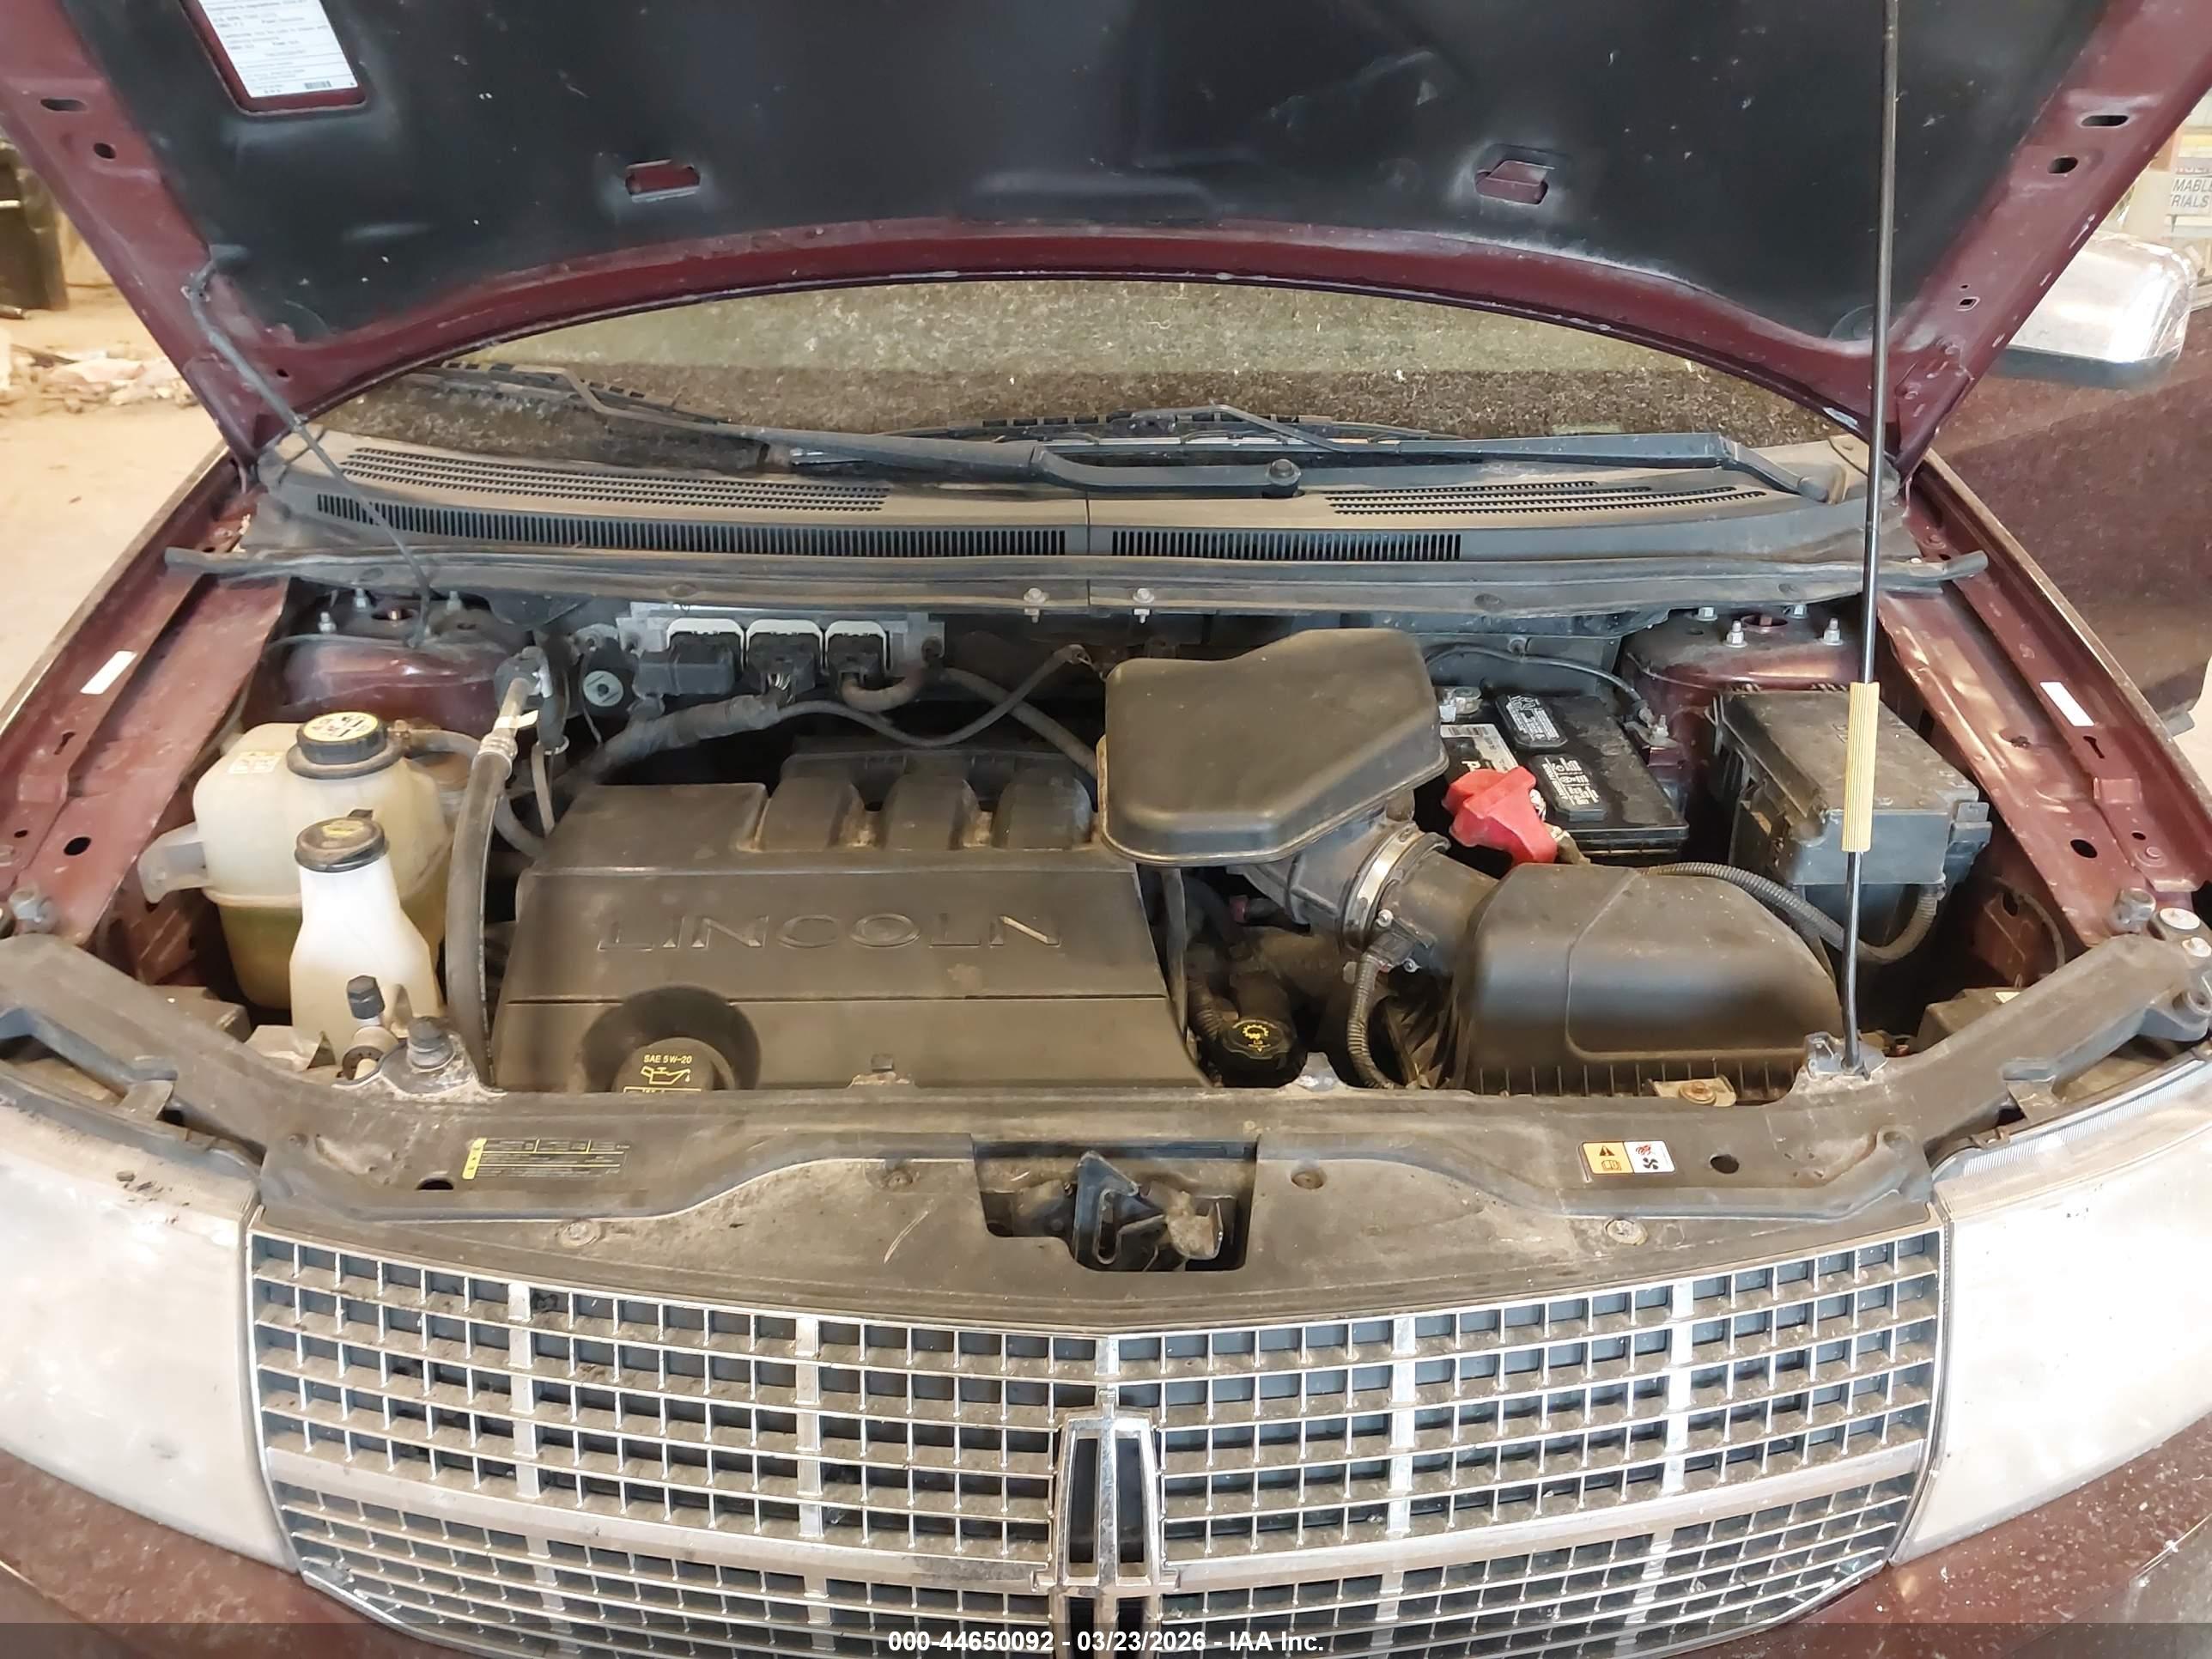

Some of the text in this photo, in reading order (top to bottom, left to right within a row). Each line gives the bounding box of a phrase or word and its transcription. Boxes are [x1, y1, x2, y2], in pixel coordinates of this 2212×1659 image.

[597, 913, 1061, 951] LINCOLN
[643, 1054, 693, 1065] SAE 5W-20
